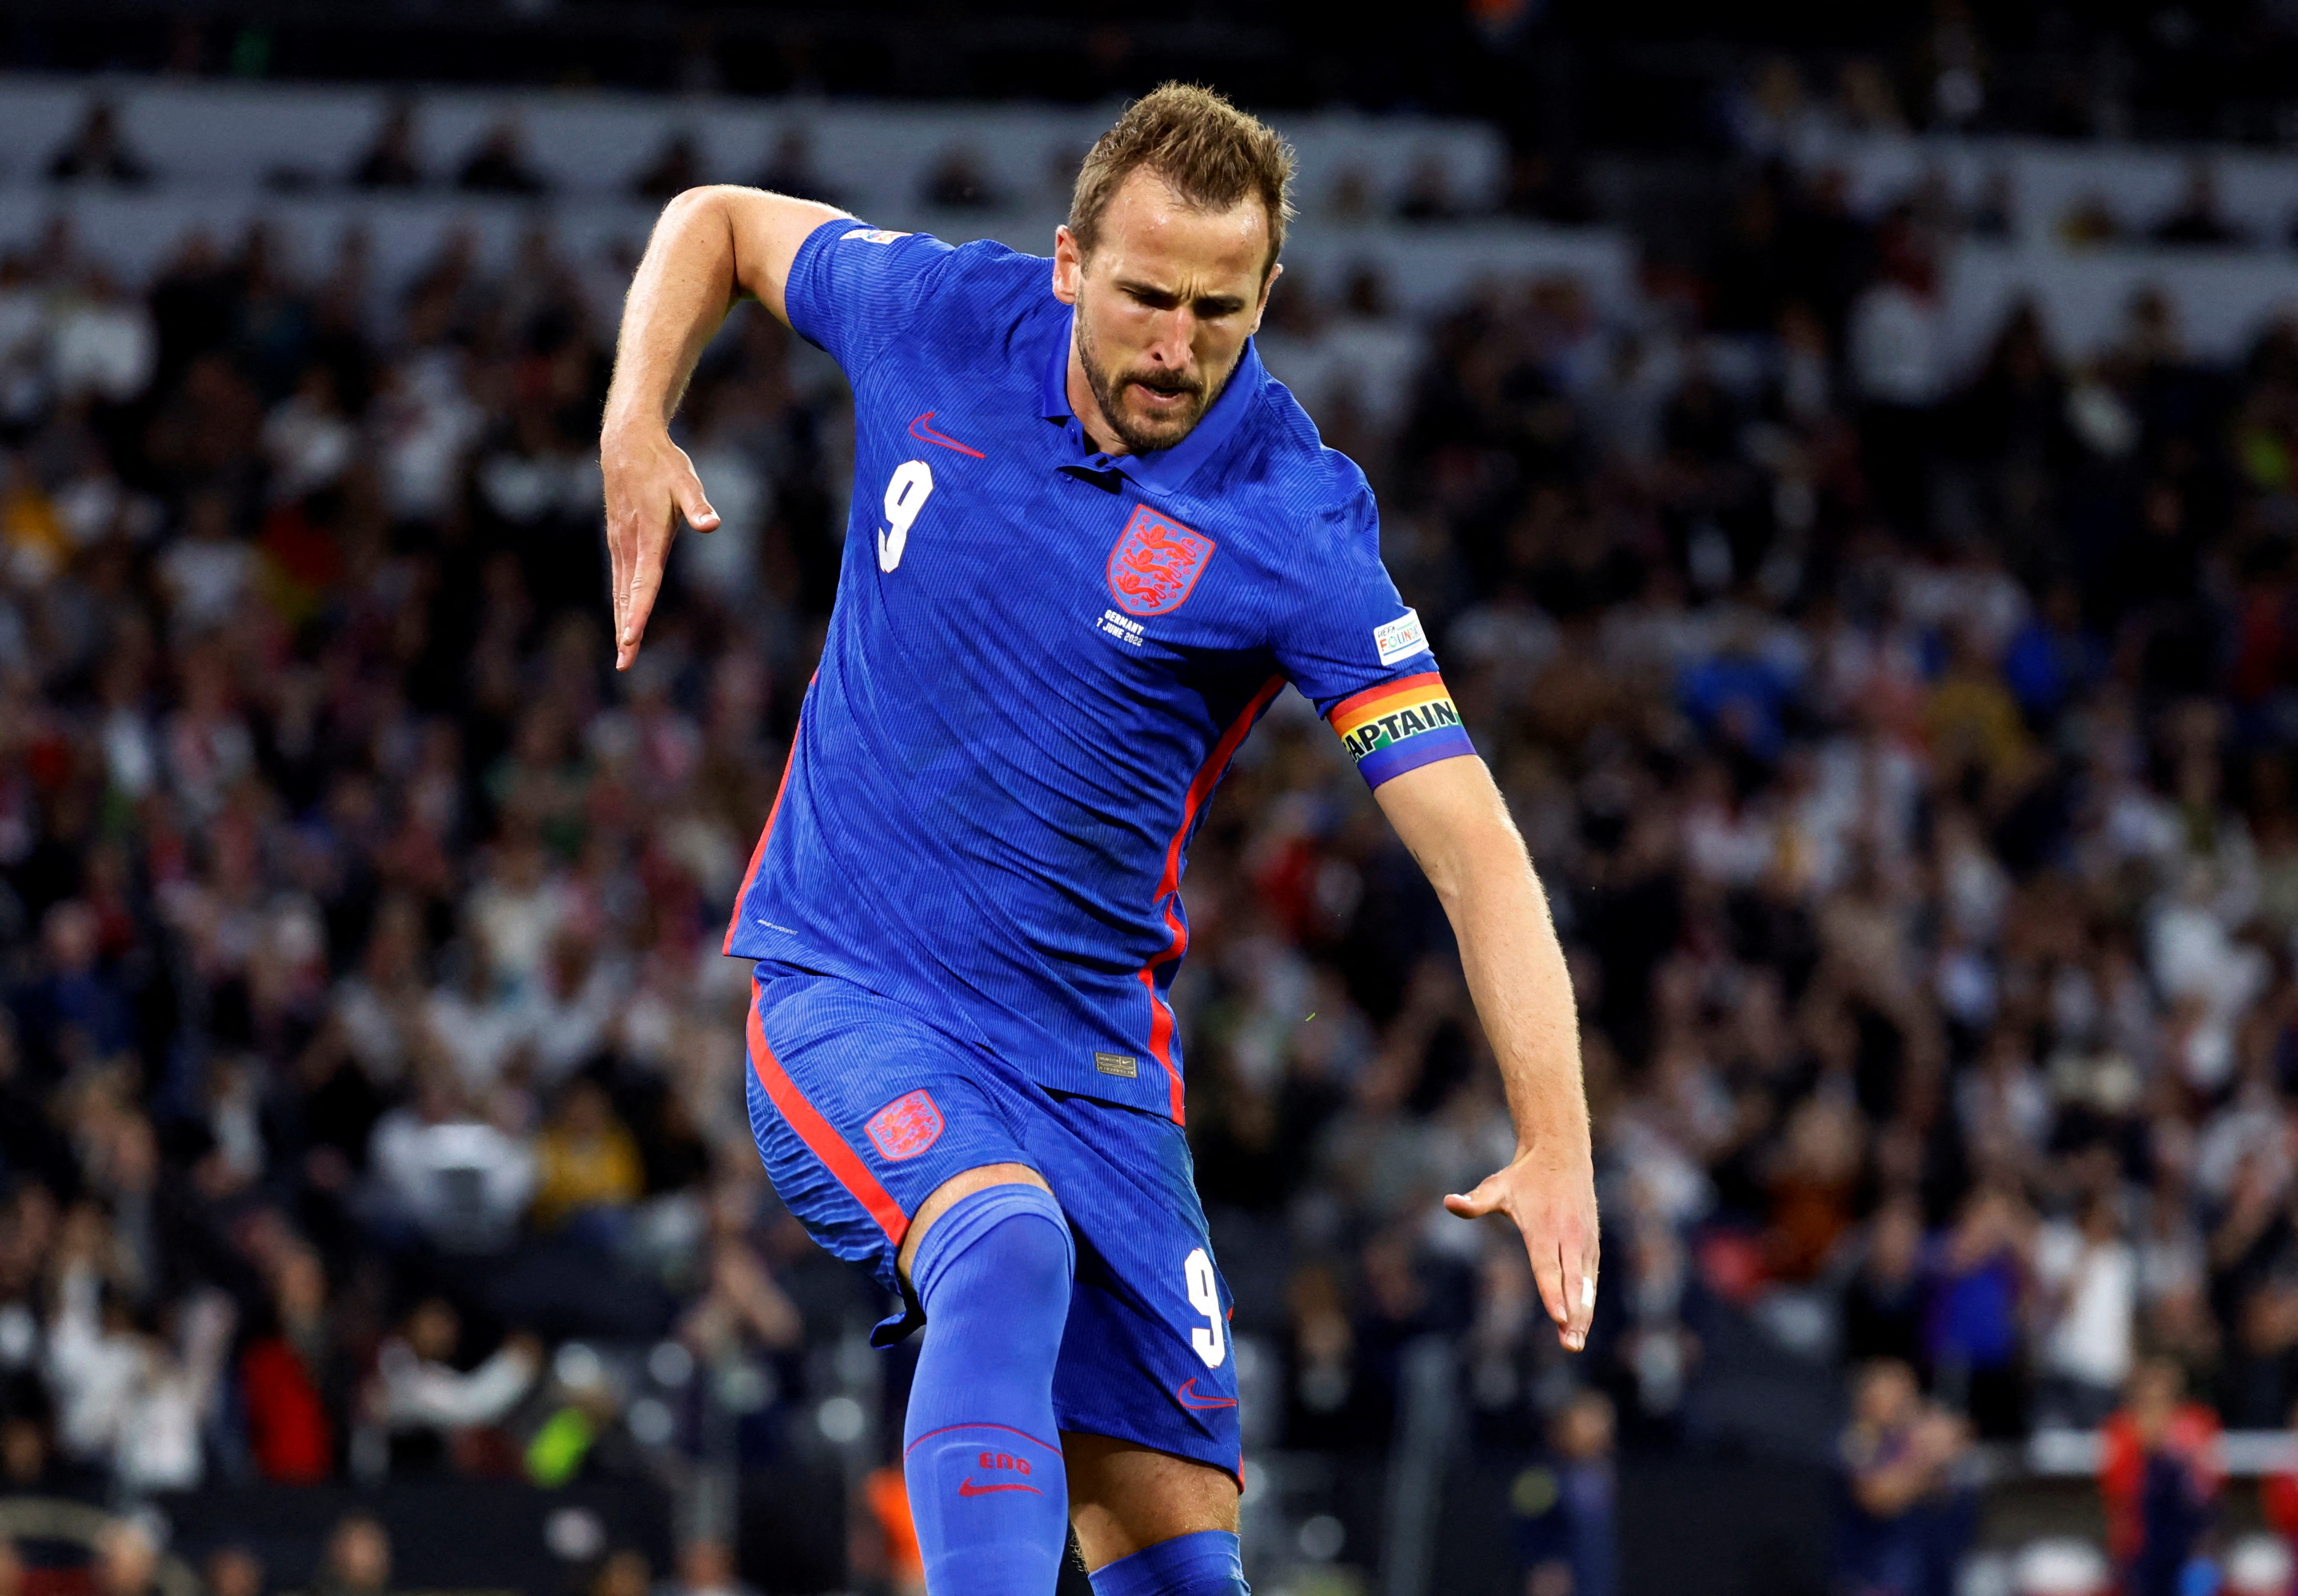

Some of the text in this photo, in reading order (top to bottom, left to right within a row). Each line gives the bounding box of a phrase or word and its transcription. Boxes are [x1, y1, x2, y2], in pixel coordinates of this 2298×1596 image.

[878, 459, 934, 574] 9
[1096, 617, 1143, 647] 7 JUNE 2022
[1104, 609, 1145, 635] GERMANY
[1377, 625, 1396, 638] UEFA
[1343, 701, 1458, 762] APTAIN
[1184, 1248, 1226, 1369] 9
